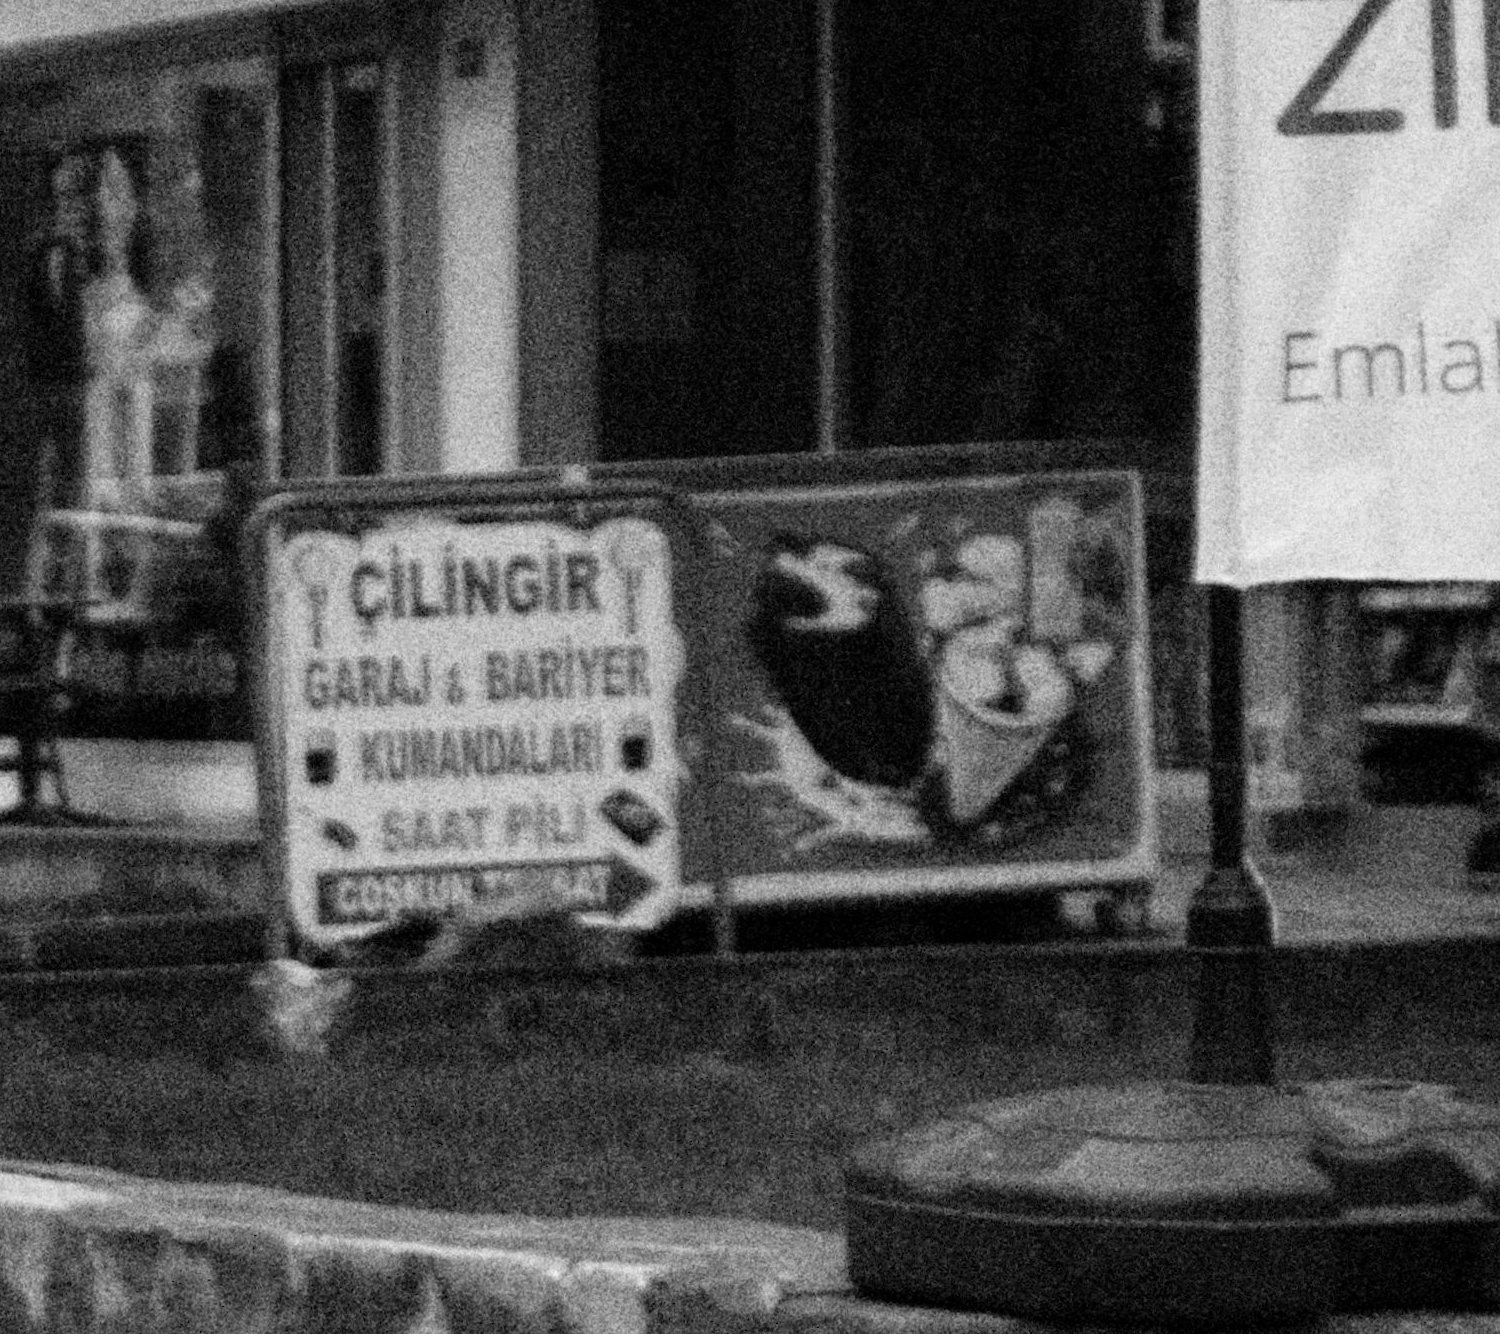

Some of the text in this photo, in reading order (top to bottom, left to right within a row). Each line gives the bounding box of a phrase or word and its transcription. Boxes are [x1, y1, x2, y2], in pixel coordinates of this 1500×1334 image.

[1280, 319, 1500, 405] Emla
[350, 539, 600, 639] ÇİLİNGİR
[305, 653, 433, 711] GARAJ
[360, 721, 605, 781] KUMANDALARI
[381, 802, 490, 853] SAAT
